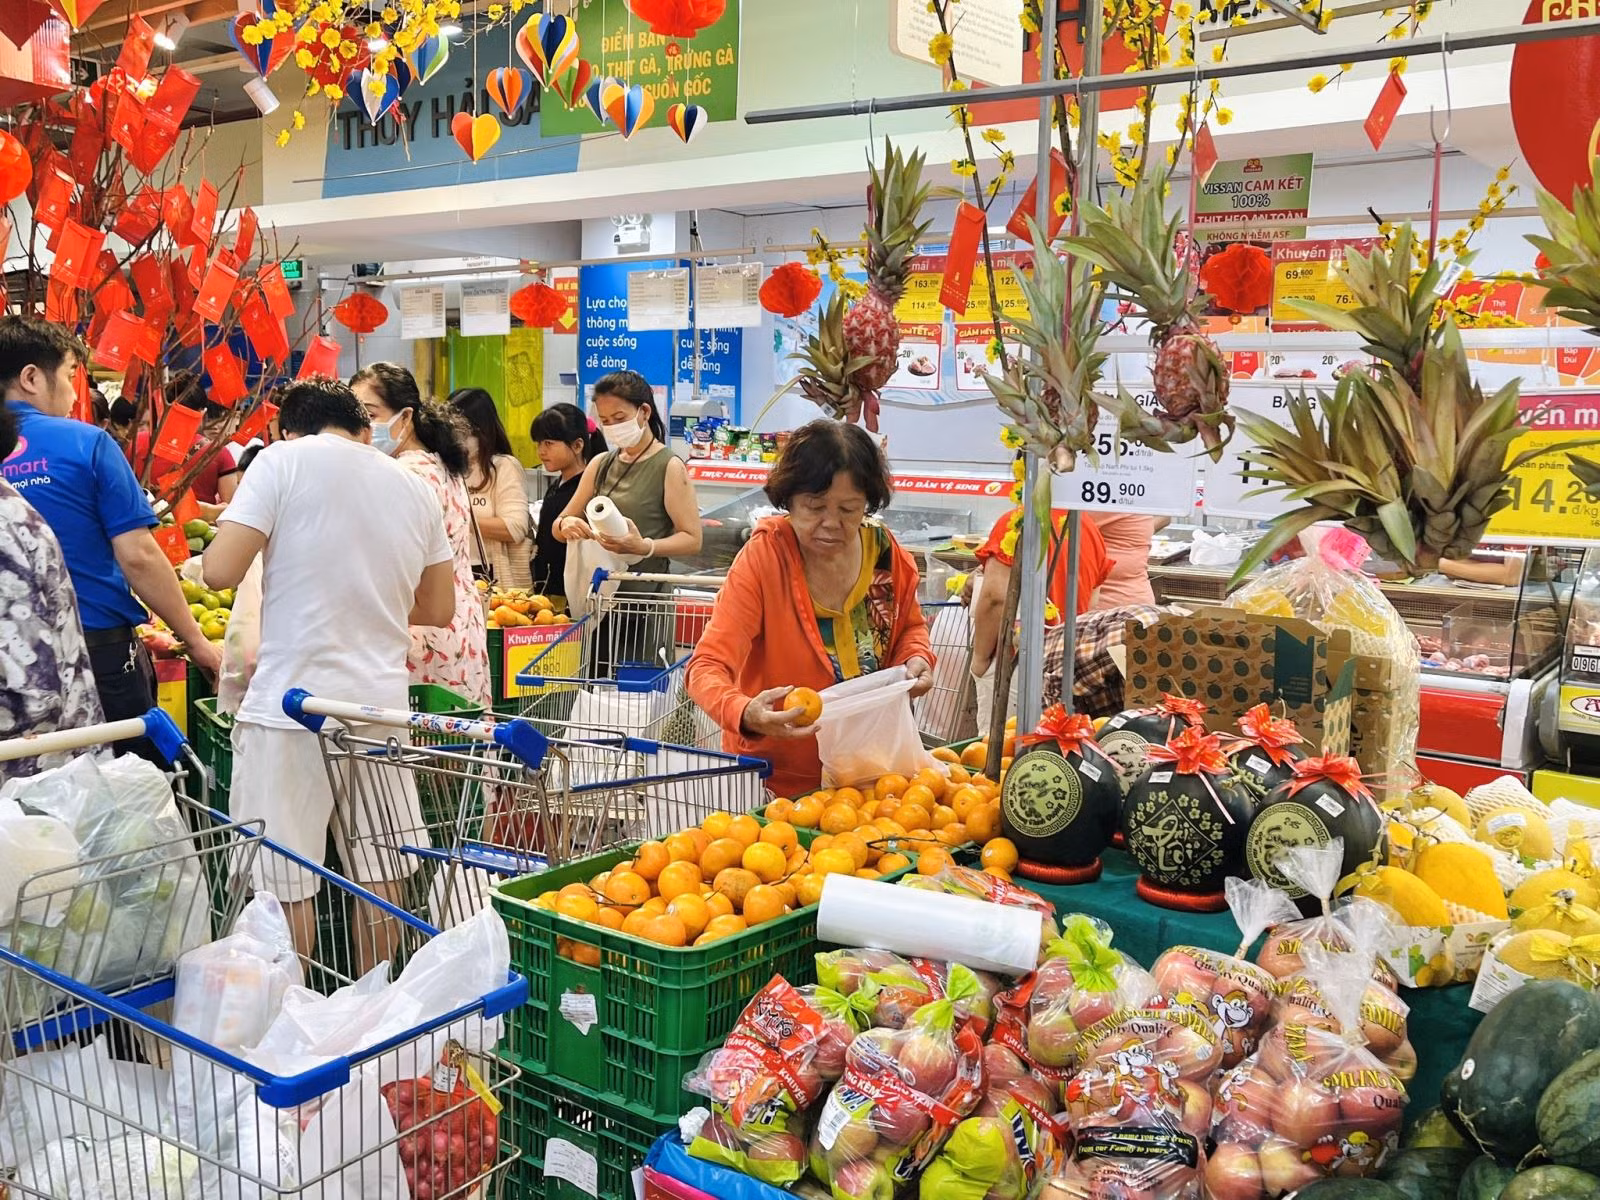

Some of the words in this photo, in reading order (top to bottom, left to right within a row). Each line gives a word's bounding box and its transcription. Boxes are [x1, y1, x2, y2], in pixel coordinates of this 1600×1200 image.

[602, 27, 634, 53] ĐIỂM
[639, 53, 661, 76] GÀ,
[716, 43, 734, 66] GÀ
[684, 72, 711, 96] GỐC
[1203, 181, 1243, 195] VISSAN
[1244, 179, 1274, 193] CAM
[1277, 174, 1304, 191] KẾT
[1231, 193, 1271, 209] 100%
[1207, 229, 1239, 241] KHÔNG
[1272, 230, 1291, 239] ASF
[1276, 245, 1326, 261] Khuyến
[586, 297, 606, 312] Lựa
[608, 296, 628, 311] chọ
[587, 317, 615, 331] thông
[586, 337, 610, 351] cuộc
[612, 333, 637, 350] sống
[681, 338, 705, 350] cuc
[586, 352, 599, 368] dễ
[601, 354, 628, 371] dàng
[31, 475, 51, 485] nhà
[508, 631, 543, 645] Khuyến
[1373, 1094, 1401, 1109] Qual
[1109, 1145, 1135, 1154] Family
